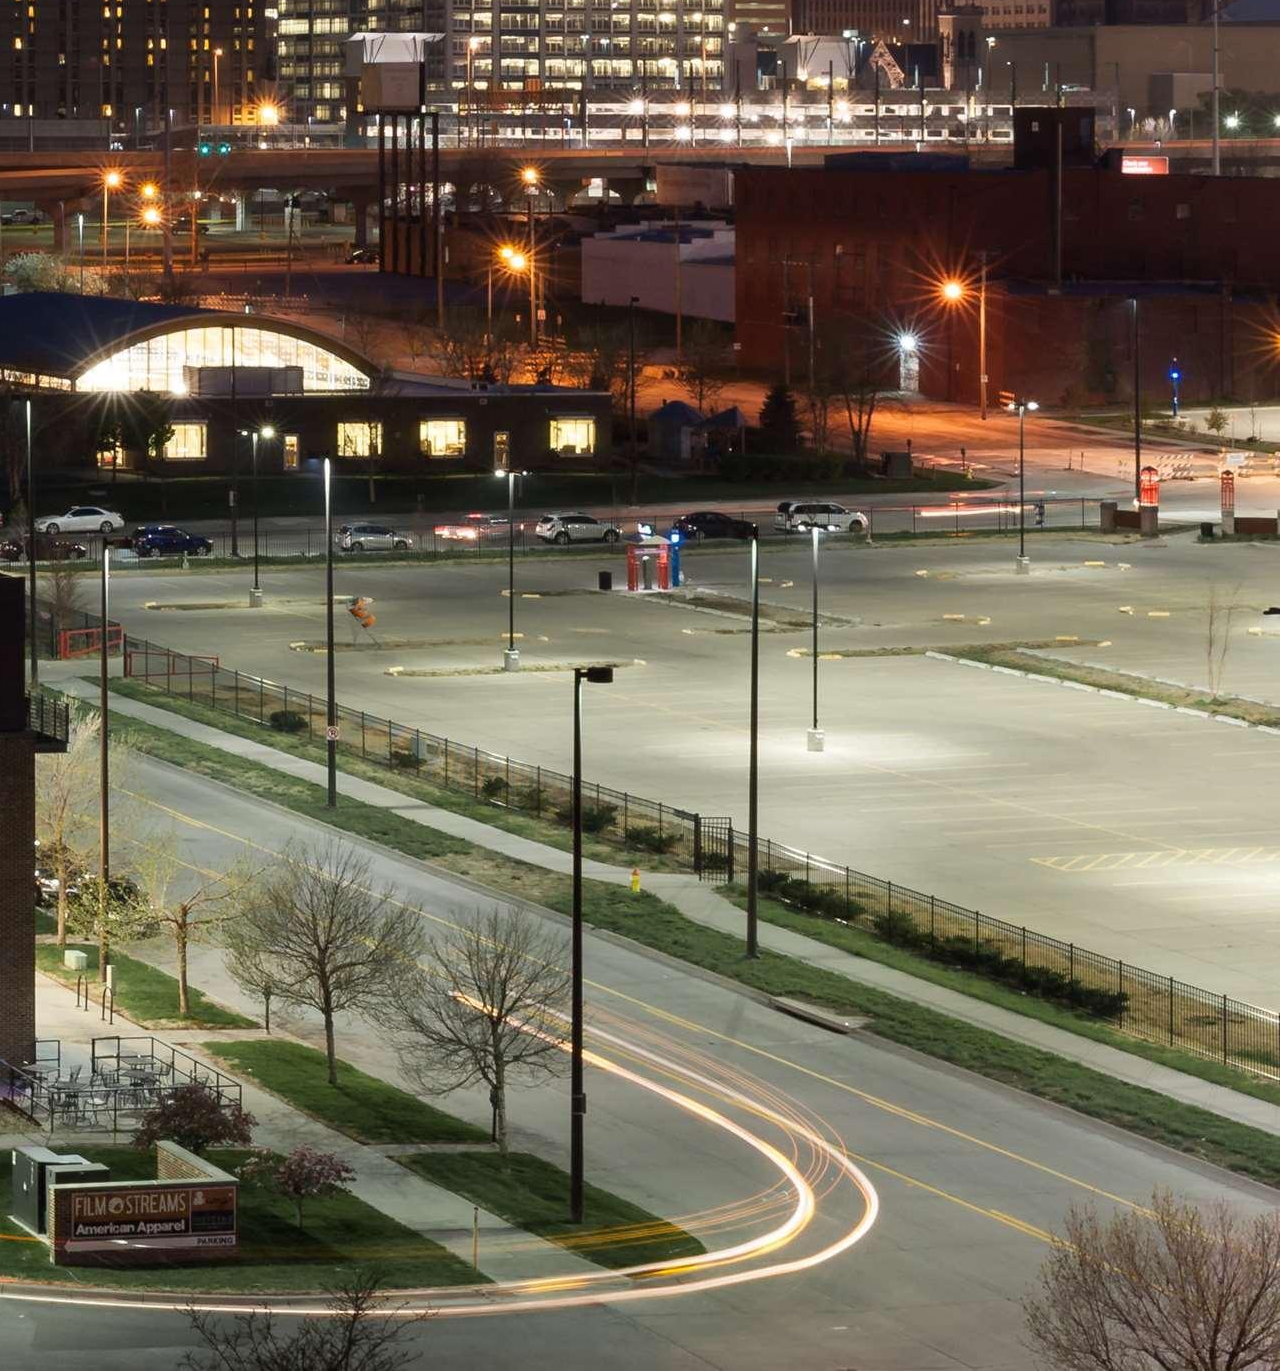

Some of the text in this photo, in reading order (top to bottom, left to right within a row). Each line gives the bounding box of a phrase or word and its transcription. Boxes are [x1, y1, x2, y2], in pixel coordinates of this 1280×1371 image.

[75, 1195, 106, 1217] FILM
[126, 1193, 186, 1214] STREAMS
[76, 1219, 185, 1235] American Apparel
[197, 1236, 234, 1245] PARKING
